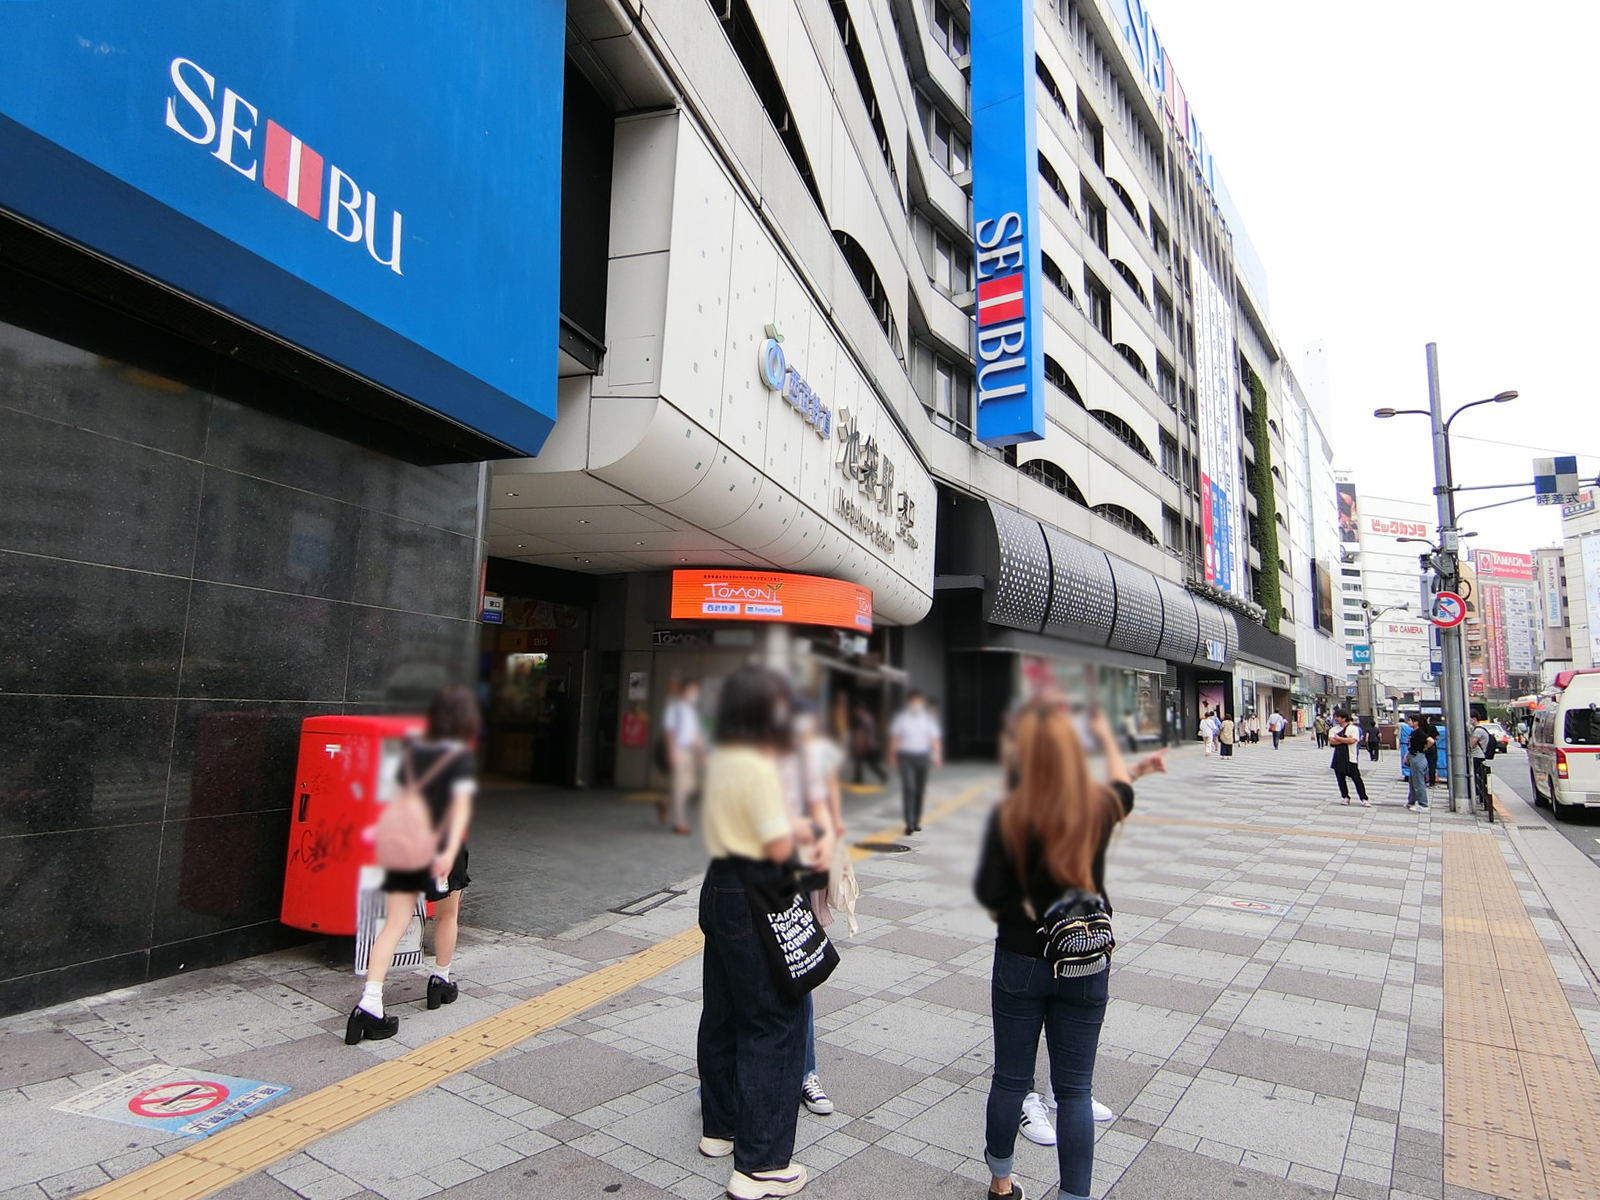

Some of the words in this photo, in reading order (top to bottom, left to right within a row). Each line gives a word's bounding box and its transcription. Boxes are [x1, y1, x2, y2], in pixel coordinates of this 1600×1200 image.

[165, 57, 405, 277] SEIBU
[975, 211, 1029, 409] SEIBU
[783, 364, 831, 440] 西武鉄道
[835, 405, 895, 517] 池袋駅
[897, 490, 916, 528] 東口
[1537, 493, 1579, 505] 時差式
[1371, 519, 1427, 537] ビックカメラ
[533, 637, 549, 647] BIG
[1400, 626, 1424, 635] CAMERA
[794, 924, 817, 947] RIGHT
